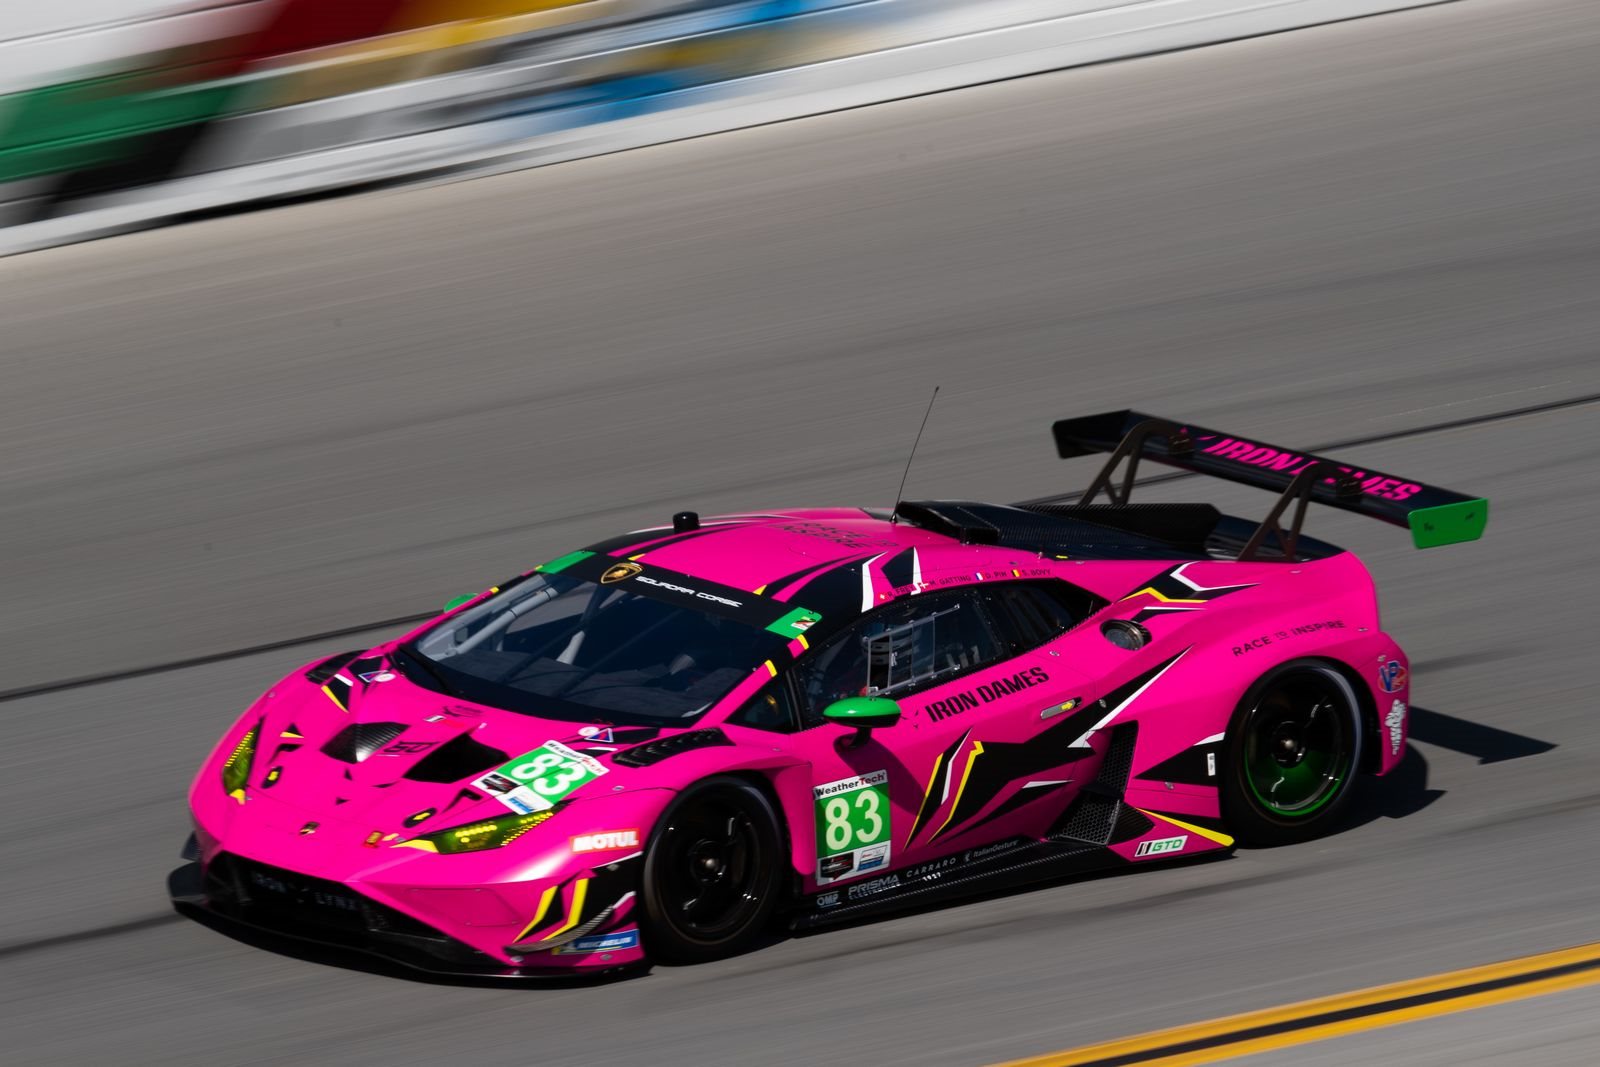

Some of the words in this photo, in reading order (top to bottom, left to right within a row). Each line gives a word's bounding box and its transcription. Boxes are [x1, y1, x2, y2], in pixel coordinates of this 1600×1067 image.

[1201, 438, 1304, 471] IRON
[940, 575, 971, 585] GATTING
[1232, 636, 1272, 656] RACE
[1291, 620, 1346, 636] INSPIRE
[925, 691, 979, 723] IRON
[977, 666, 1049, 703] DAMES
[511, 753, 587, 796] 83
[815, 771, 885, 798] WeatherTech
[825, 790, 883, 850] 83
[573, 831, 639, 852] MOTUL
[1152, 839, 1183, 852] GTD
[906, 858, 956, 877] CARRARO
[848, 874, 900, 896] PRISMA
[816, 893, 839, 906] OMP
